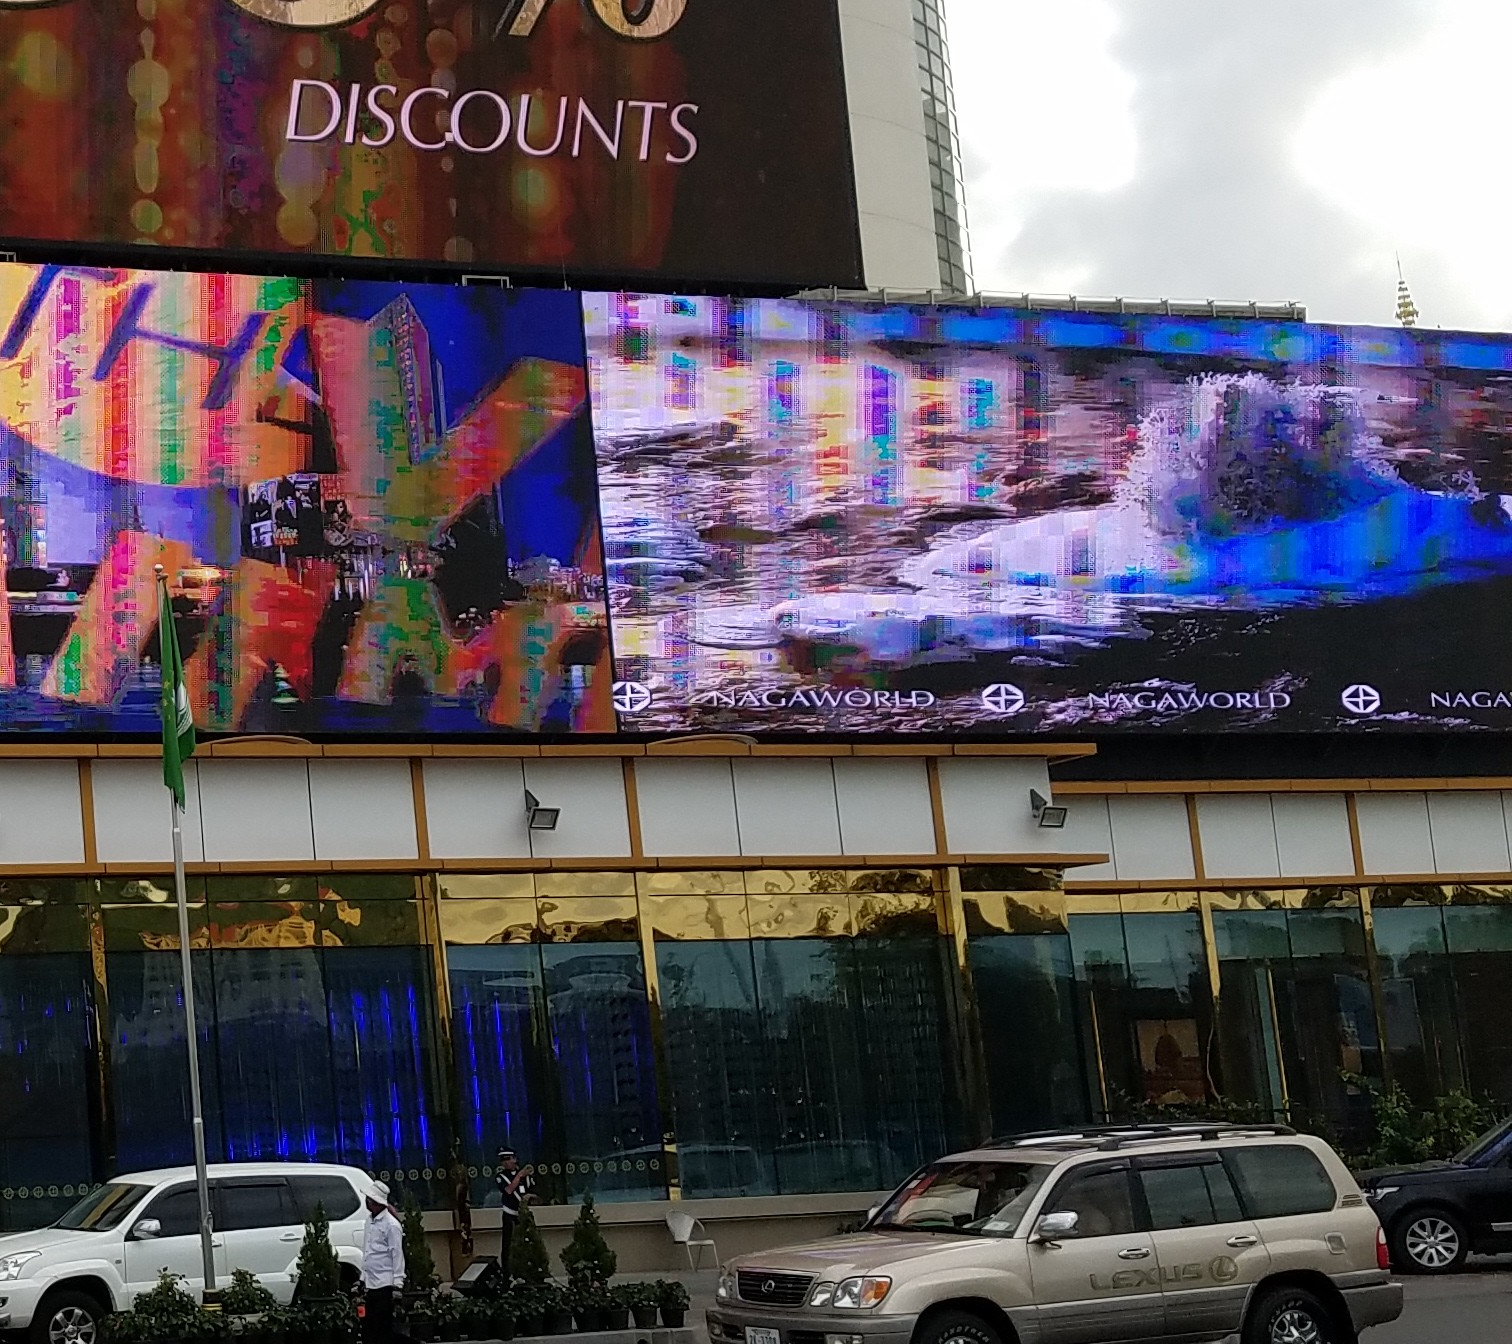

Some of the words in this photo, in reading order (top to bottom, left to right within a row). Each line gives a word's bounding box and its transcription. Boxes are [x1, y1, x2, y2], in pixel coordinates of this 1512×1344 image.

[285, 77, 701, 165] DISCOUNTS
[711, 688, 937, 709] NAGAWORLD
[1088, 690, 1292, 710] NAGAWORLD
[1430, 690, 1512, 709] NAGA
[1089, 1262, 1204, 1291] LEXUS
